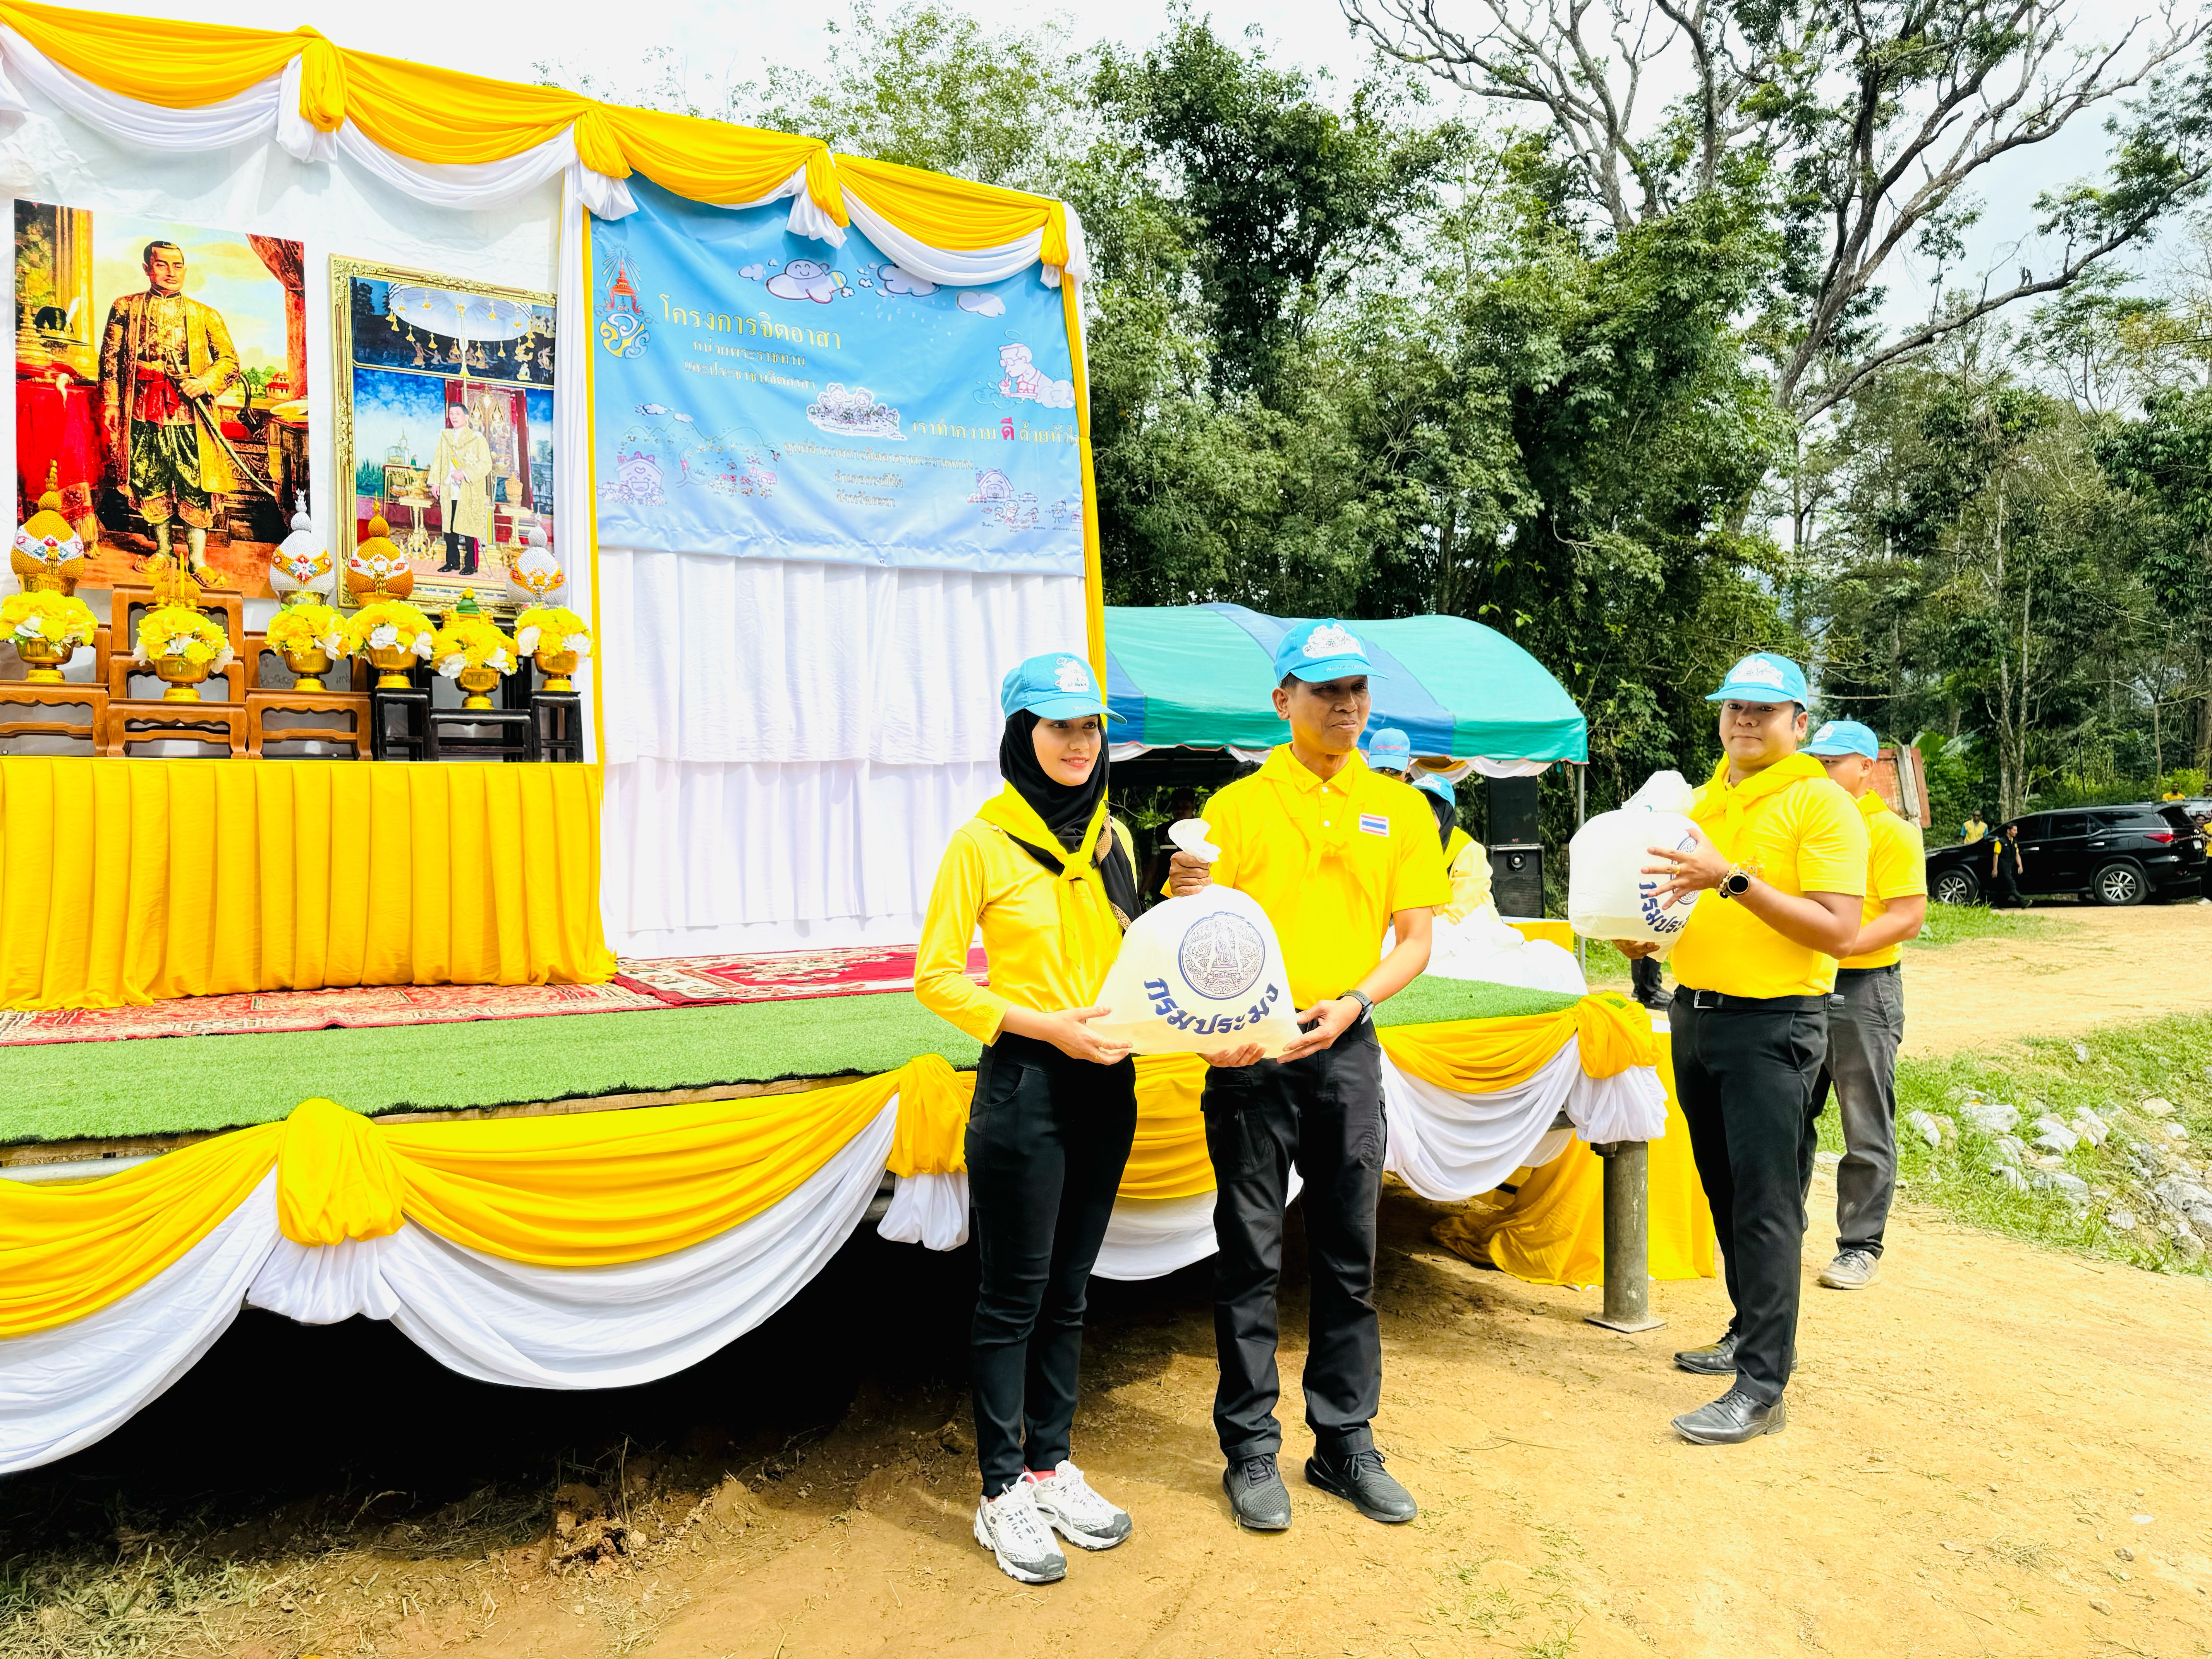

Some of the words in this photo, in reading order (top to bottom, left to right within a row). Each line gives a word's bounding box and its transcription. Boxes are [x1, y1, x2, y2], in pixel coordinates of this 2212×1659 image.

[659, 293, 841, 350] โครงการจิตอาสา
[692, 337, 805, 367] หน่วยพระราชทาน
[684, 360, 816, 391] และประชาชนจิตอาสา
[912, 417, 997, 440] เราทำความ
[1000, 417, 1015, 441] ดี
[783, 438, 974, 470] ศูนย์อำนวยการจิตอาสาพระราชทาน
[836, 489, 896, 507] จังหวัดยะลา
[1639, 881, 1690, 933] กรมประ
[1144, 977, 1278, 1035] กรมประมง
